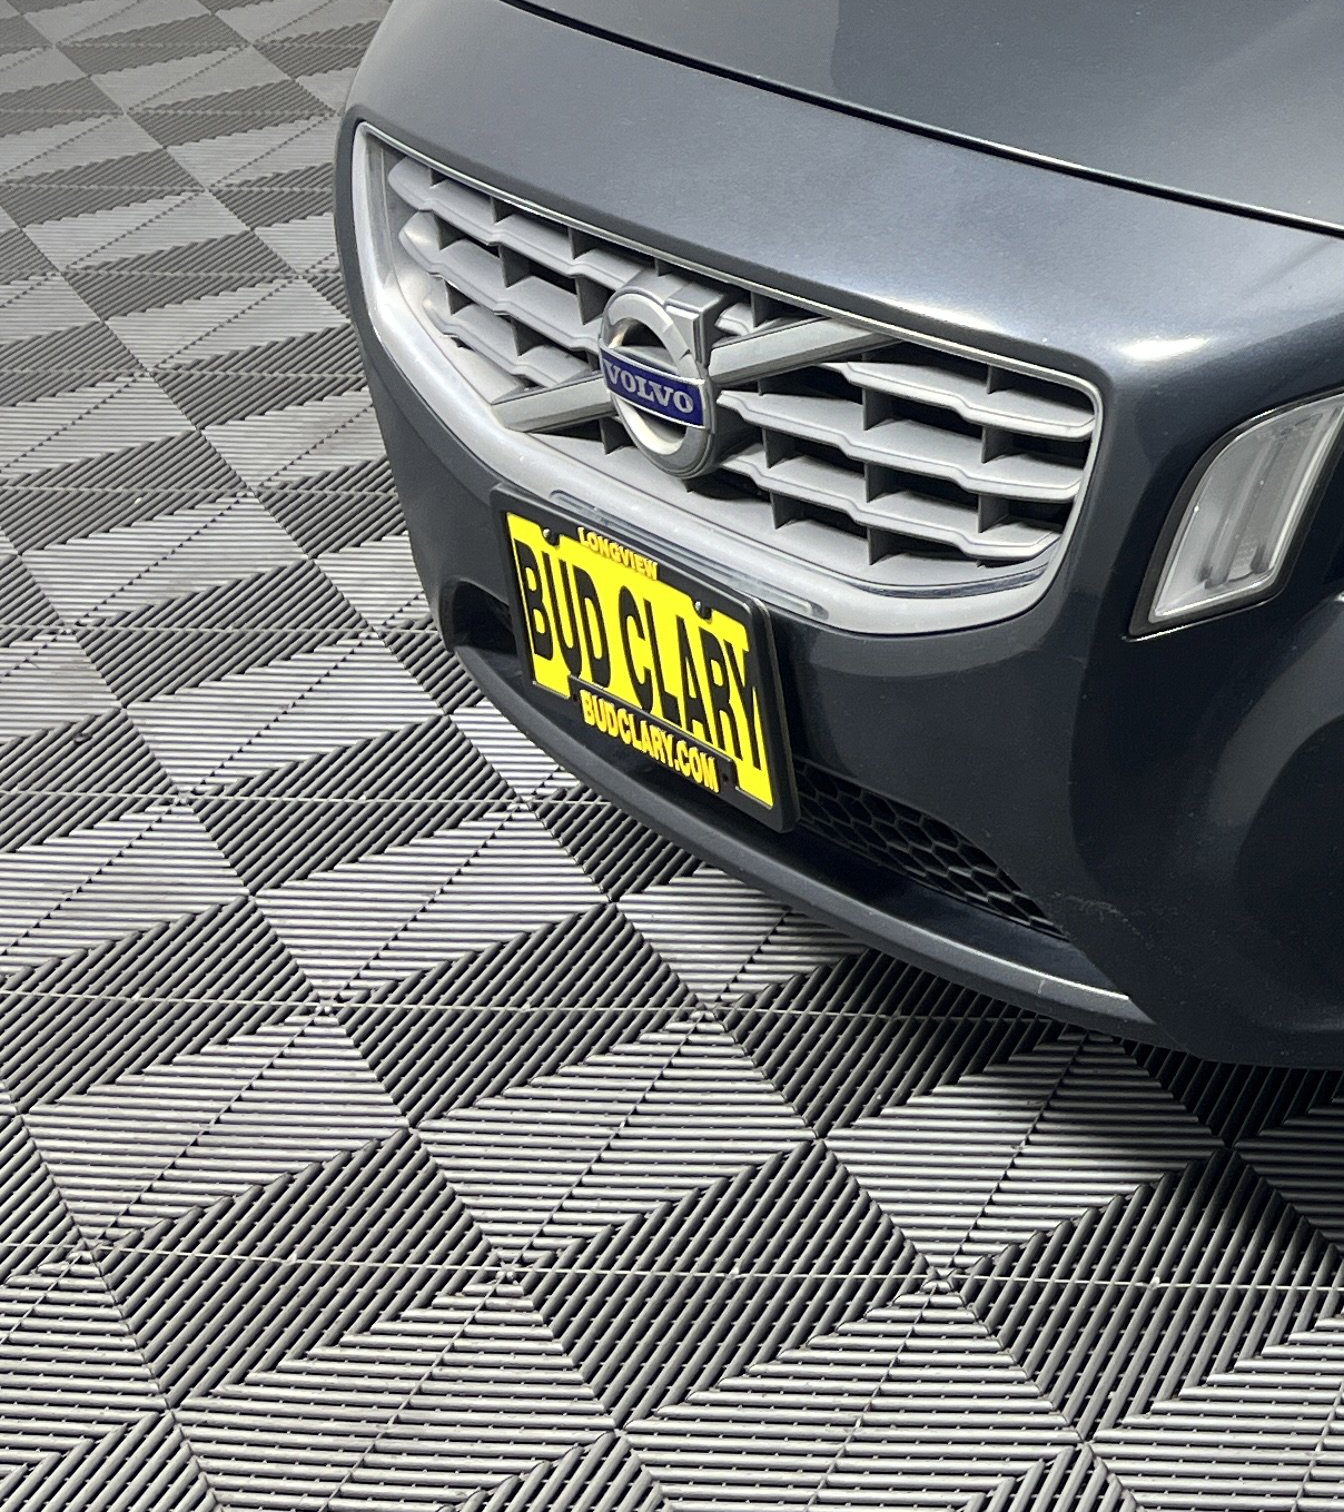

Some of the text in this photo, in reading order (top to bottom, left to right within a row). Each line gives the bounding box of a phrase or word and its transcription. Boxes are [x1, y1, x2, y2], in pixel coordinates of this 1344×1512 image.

[603, 358, 695, 414] VOLVO
[577, 526, 659, 581] LONGVIEW
[514, 539, 762, 771] BUD CLARY
[578, 689, 720, 793] BUDCLARY.COM
